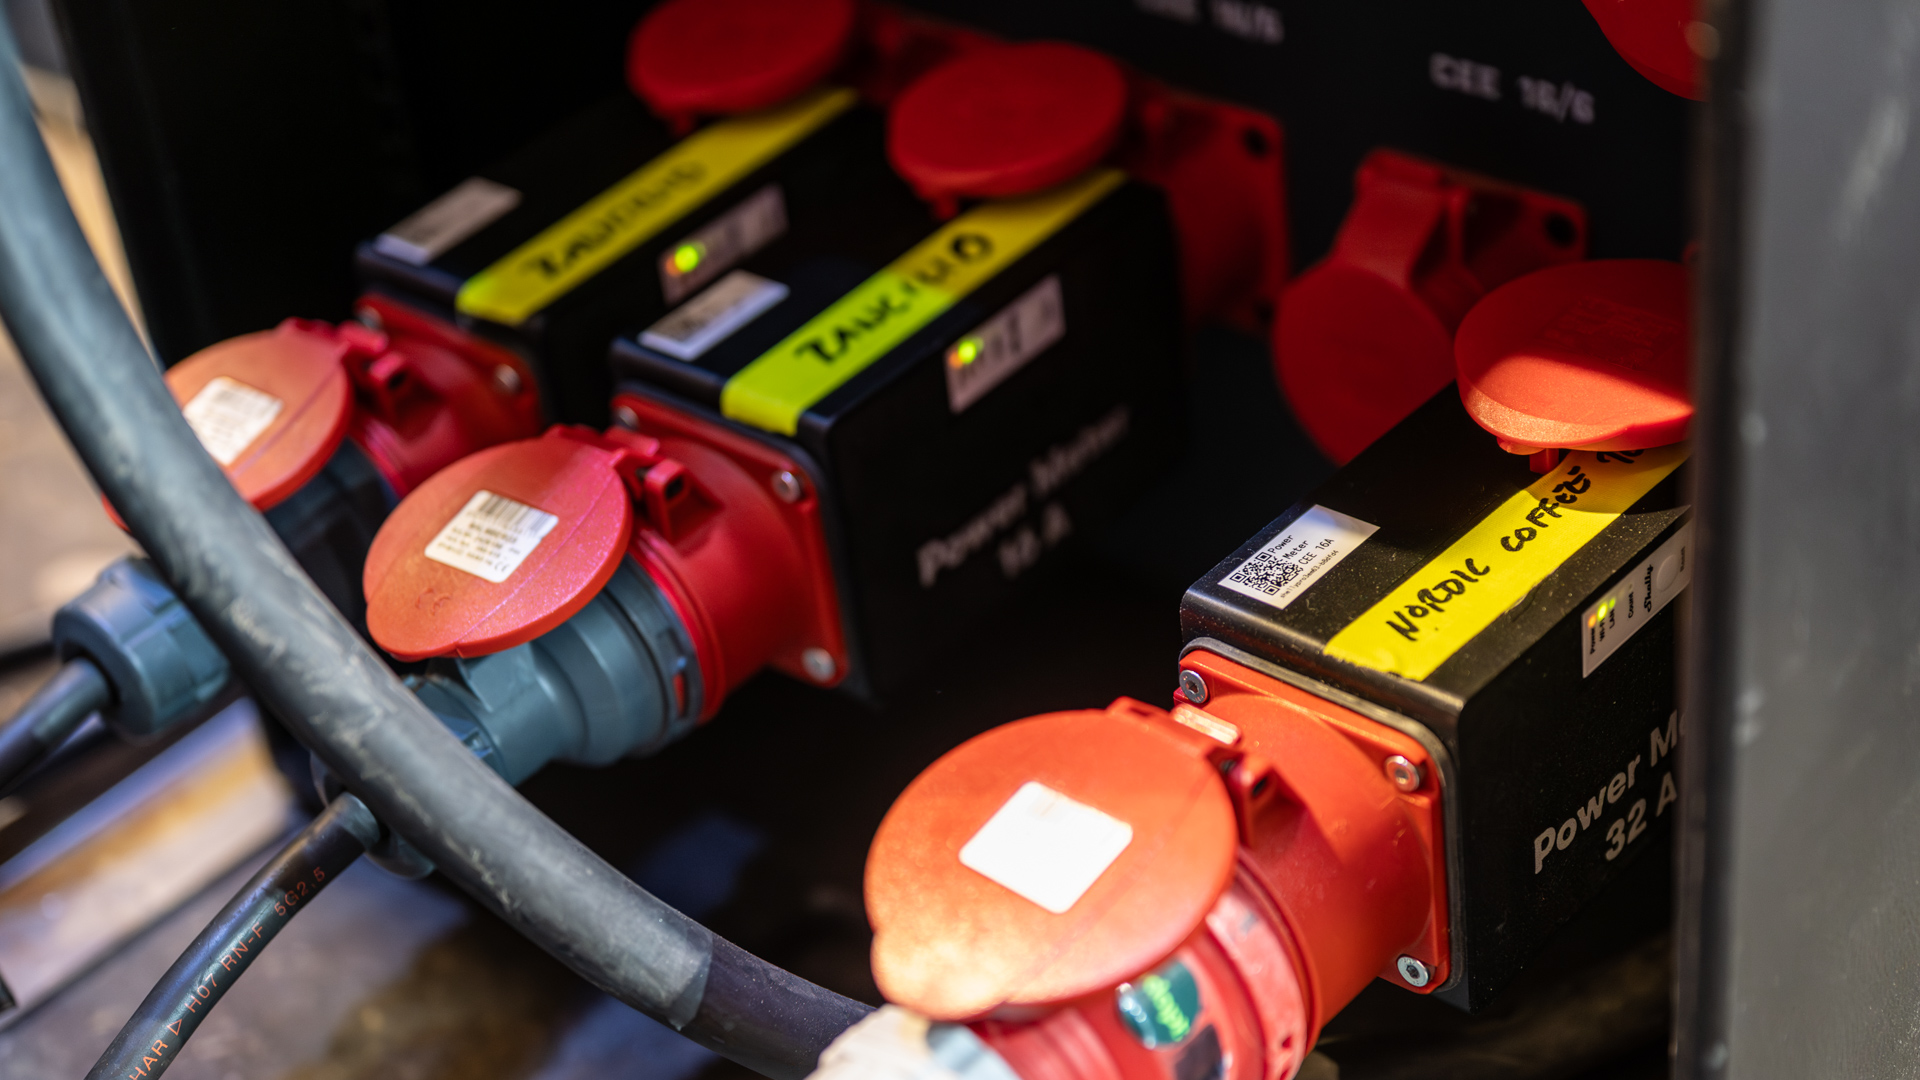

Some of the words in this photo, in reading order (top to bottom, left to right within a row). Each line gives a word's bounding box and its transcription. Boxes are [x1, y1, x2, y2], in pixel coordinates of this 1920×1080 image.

[1267, 534, 1294, 554] Power
[1282, 540, 1309, 560] Meter
[1298, 552, 1318, 566] CEE
[1315, 538, 1335, 550] 16A
[1386, 558, 1491, 642] NORDIC
[1644, 564, 1654, 613] Shelly
[1534, 754, 1641, 875] Power
[1605, 798, 1647, 861] 32
[1656, 771, 1678, 817] A
[129, 1039, 168, 1080] HAR
[184, 972, 221, 1013] H07
[220, 922, 263, 972] RN-F
